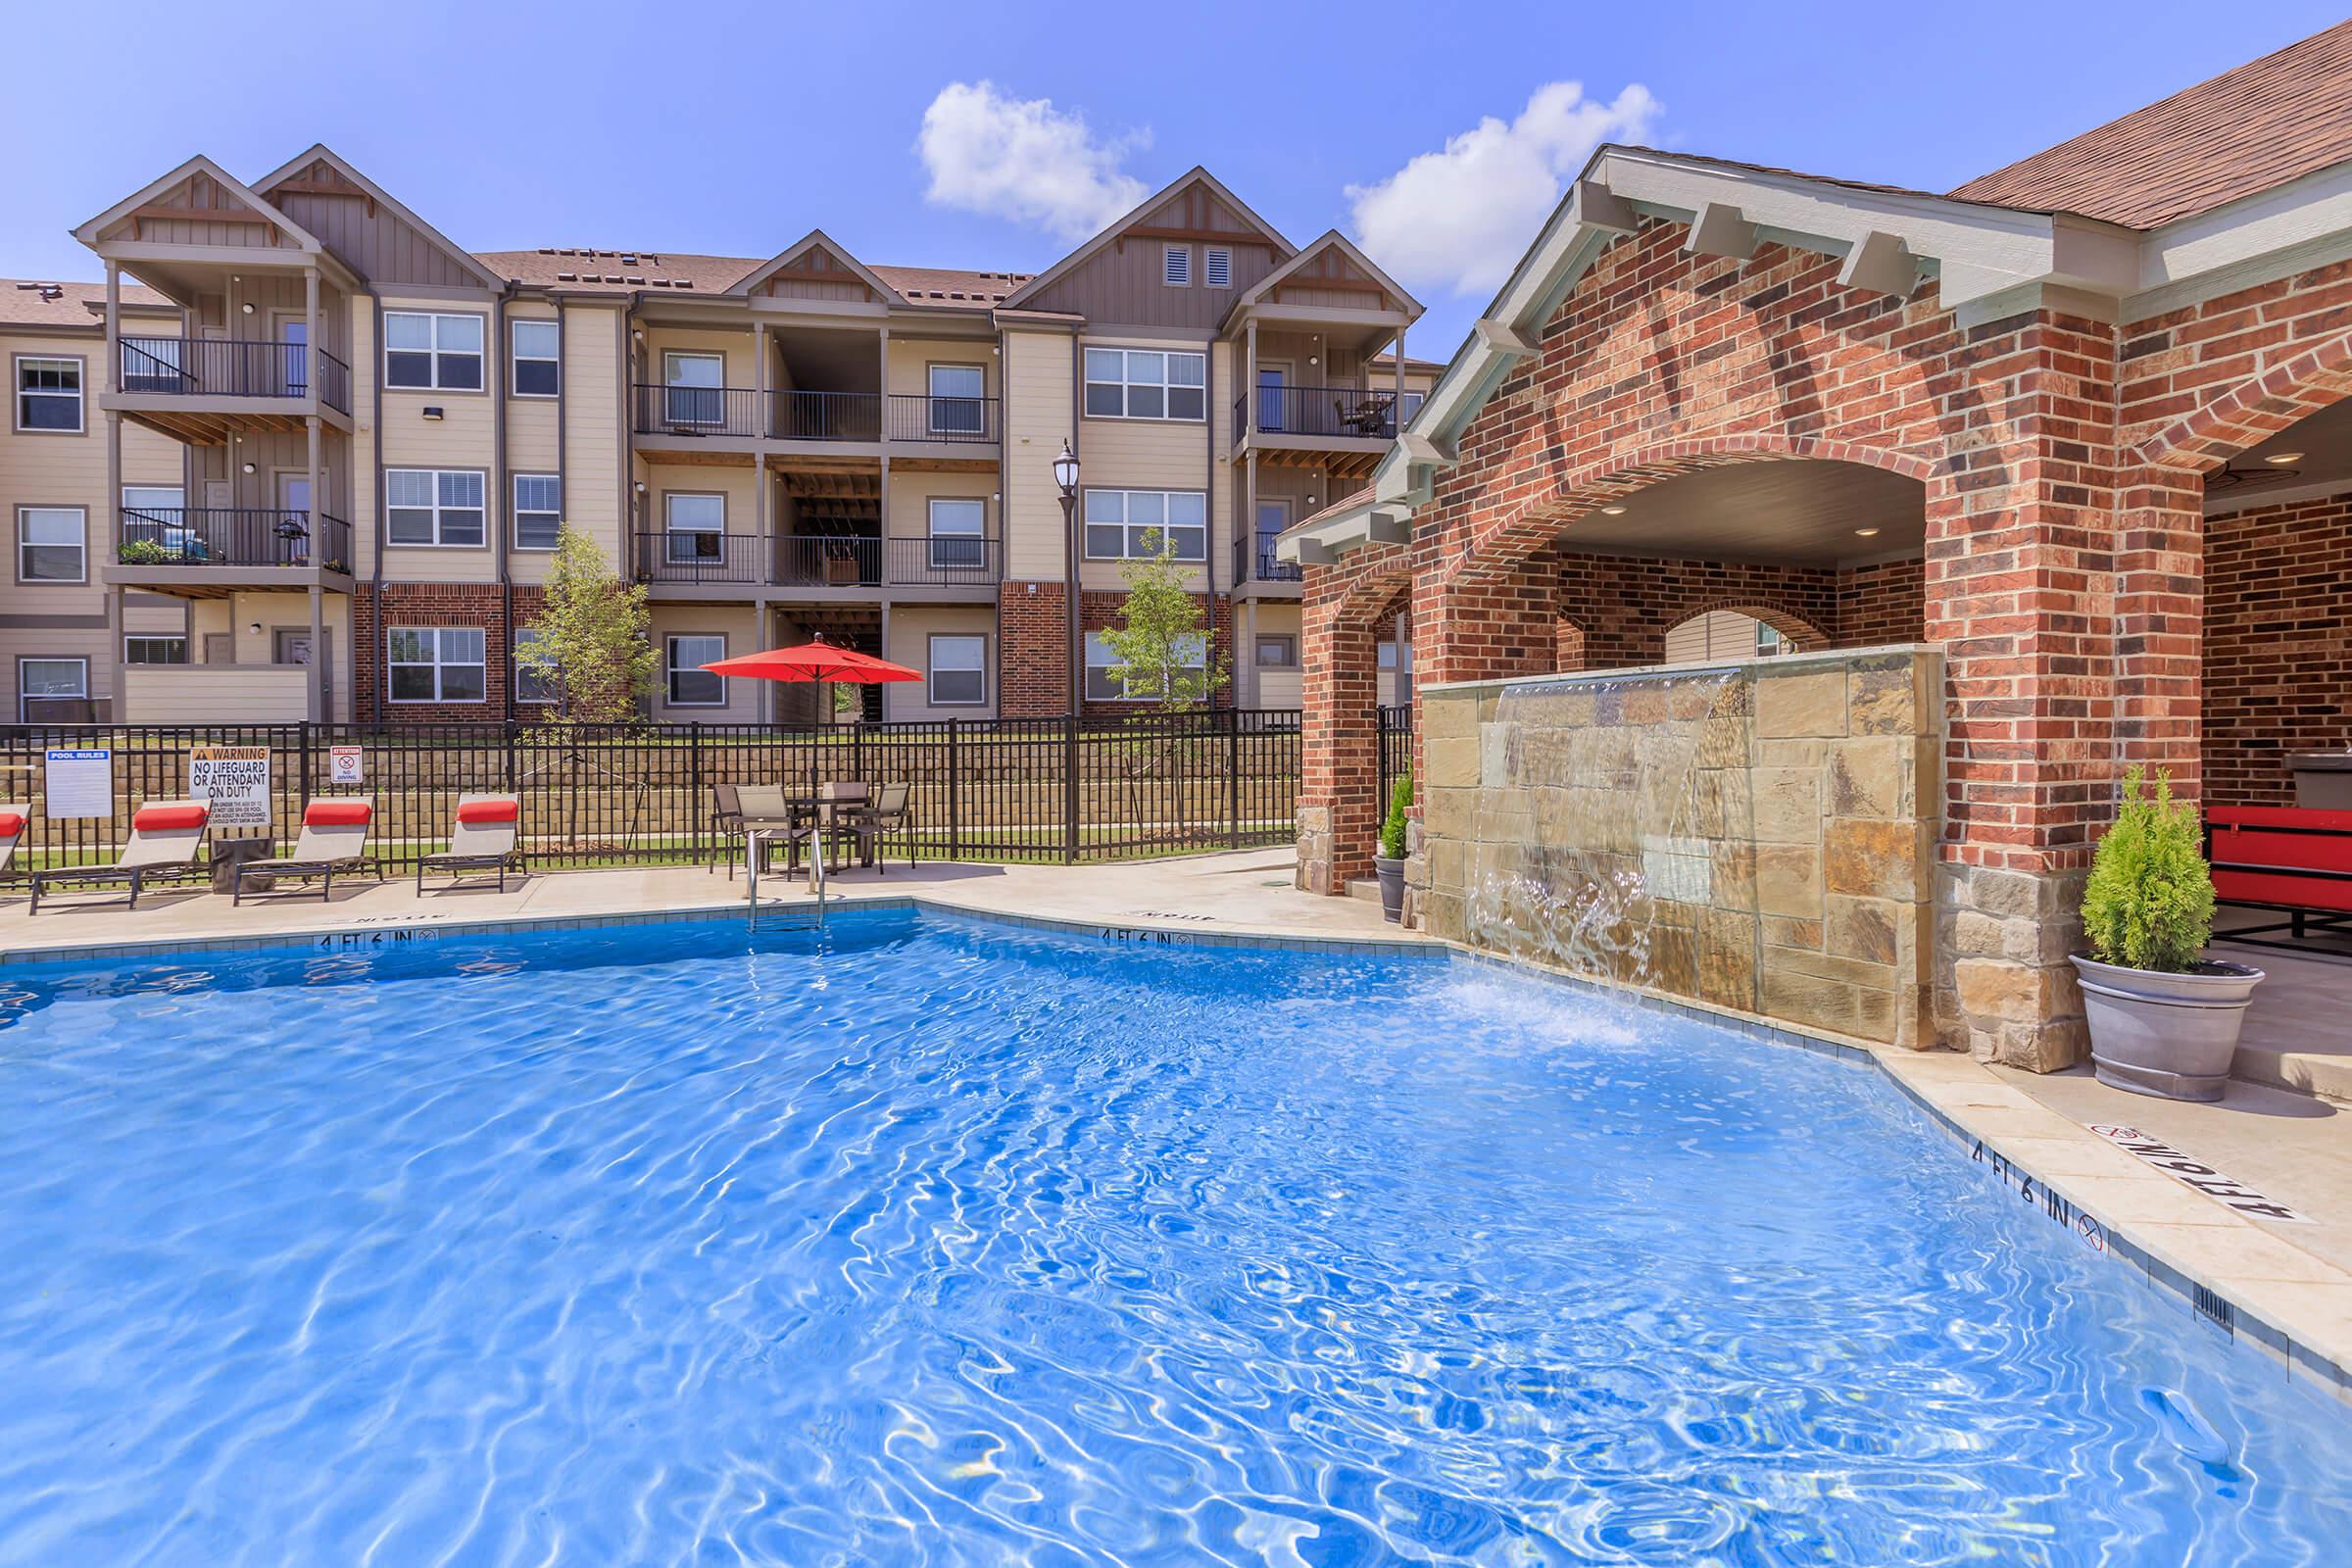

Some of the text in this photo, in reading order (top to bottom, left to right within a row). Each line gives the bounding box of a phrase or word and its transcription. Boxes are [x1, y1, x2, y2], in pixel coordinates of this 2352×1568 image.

[213, 748, 265, 760] WARNING
[194, 761, 265, 774] NO LIFEGUARD
[194, 774, 266, 786] OR ATTENDANT
[208, 786, 251, 798] ON DUTY
[320, 934, 331, 946] 4
[342, 934, 361, 946] FT
[395, 931, 412, 942] IN
[1102, 929, 1110, 940] 4
[1118, 930, 1131, 942] FT
[1157, 932, 1171, 944] IN
[2117, 1142, 2189, 1160] IN
[1972, 1140, 2069, 1228] 4 FT 6 IN
[2180, 1176, 2266, 1199] FT
[2227, 1202, 2296, 1220] 4
